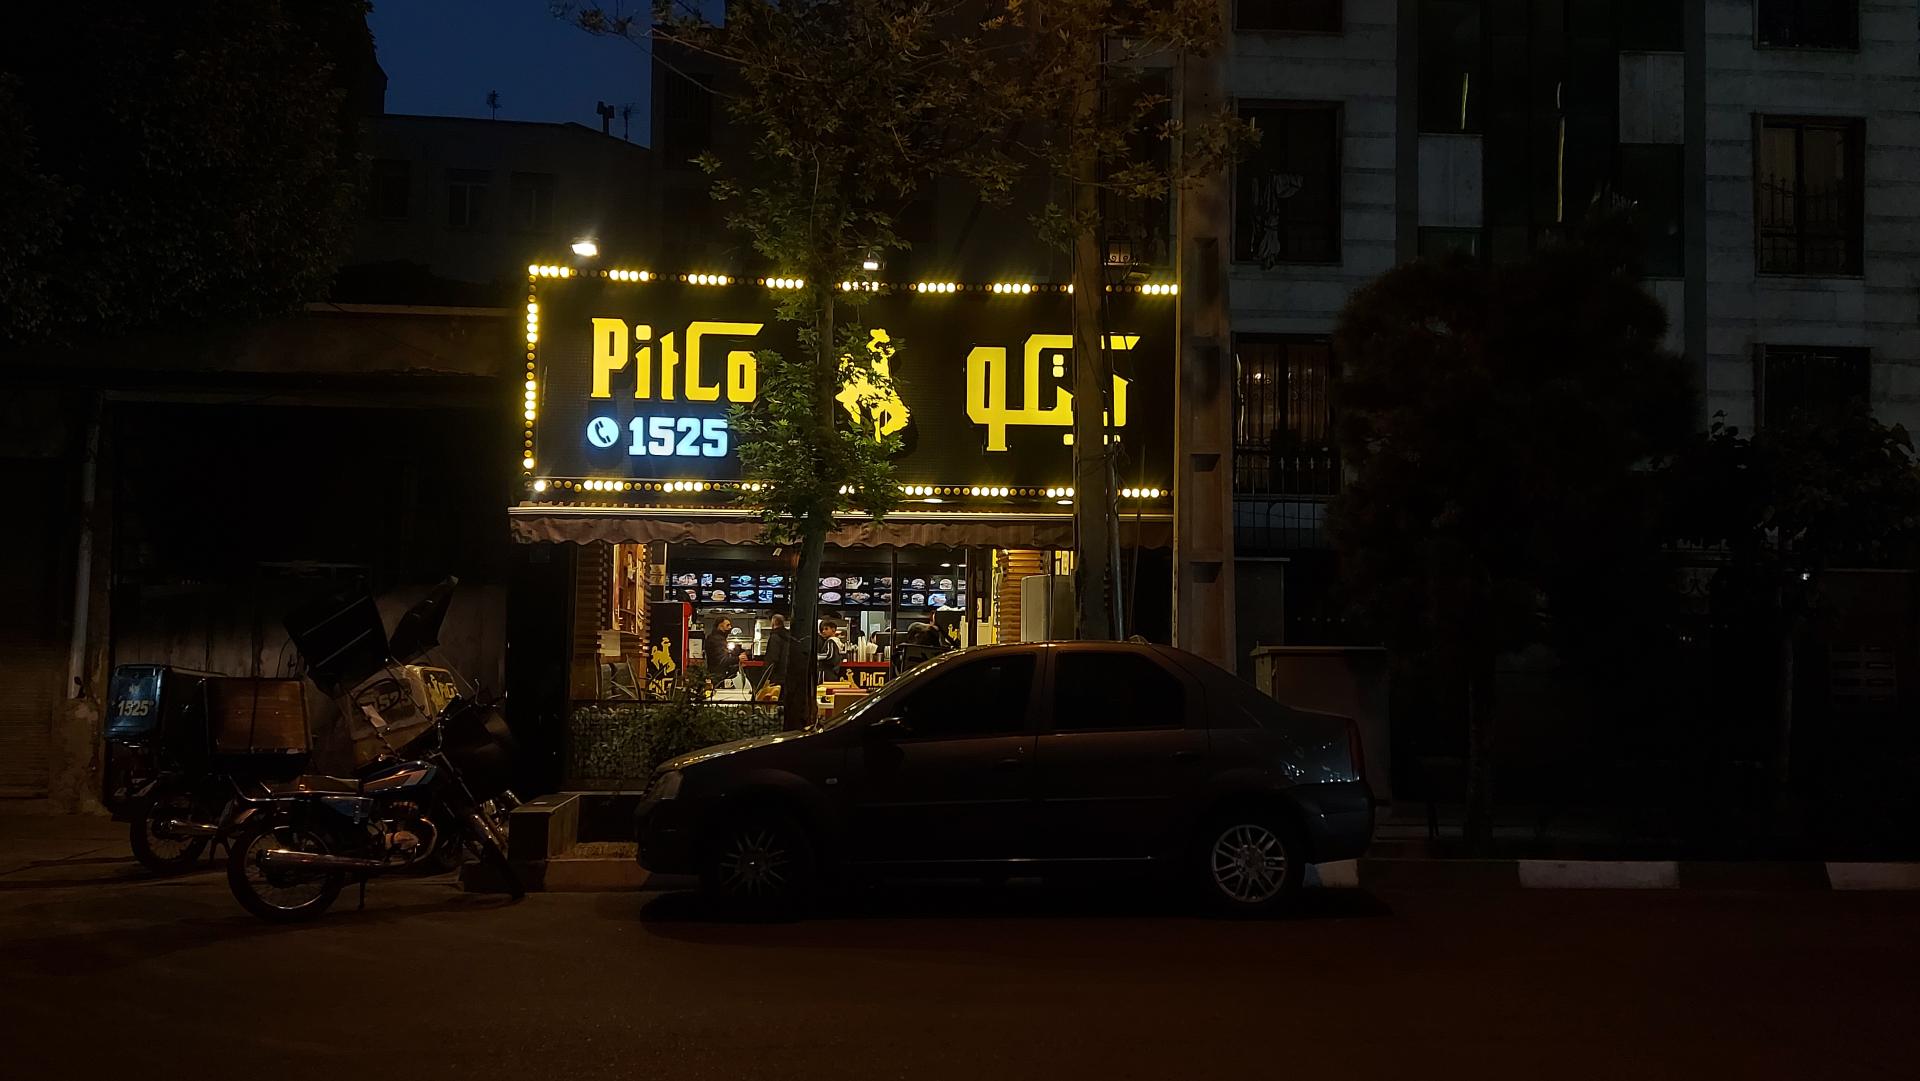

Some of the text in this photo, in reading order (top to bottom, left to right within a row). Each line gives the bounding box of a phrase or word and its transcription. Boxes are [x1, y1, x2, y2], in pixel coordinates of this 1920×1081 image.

[591, 317, 764, 403] PitCo
[967, 333, 1141, 451] پتکو
[628, 416, 728, 457] 1525
[859, 671, 886, 687] PitCo
[118, 699, 150, 717] 1525
